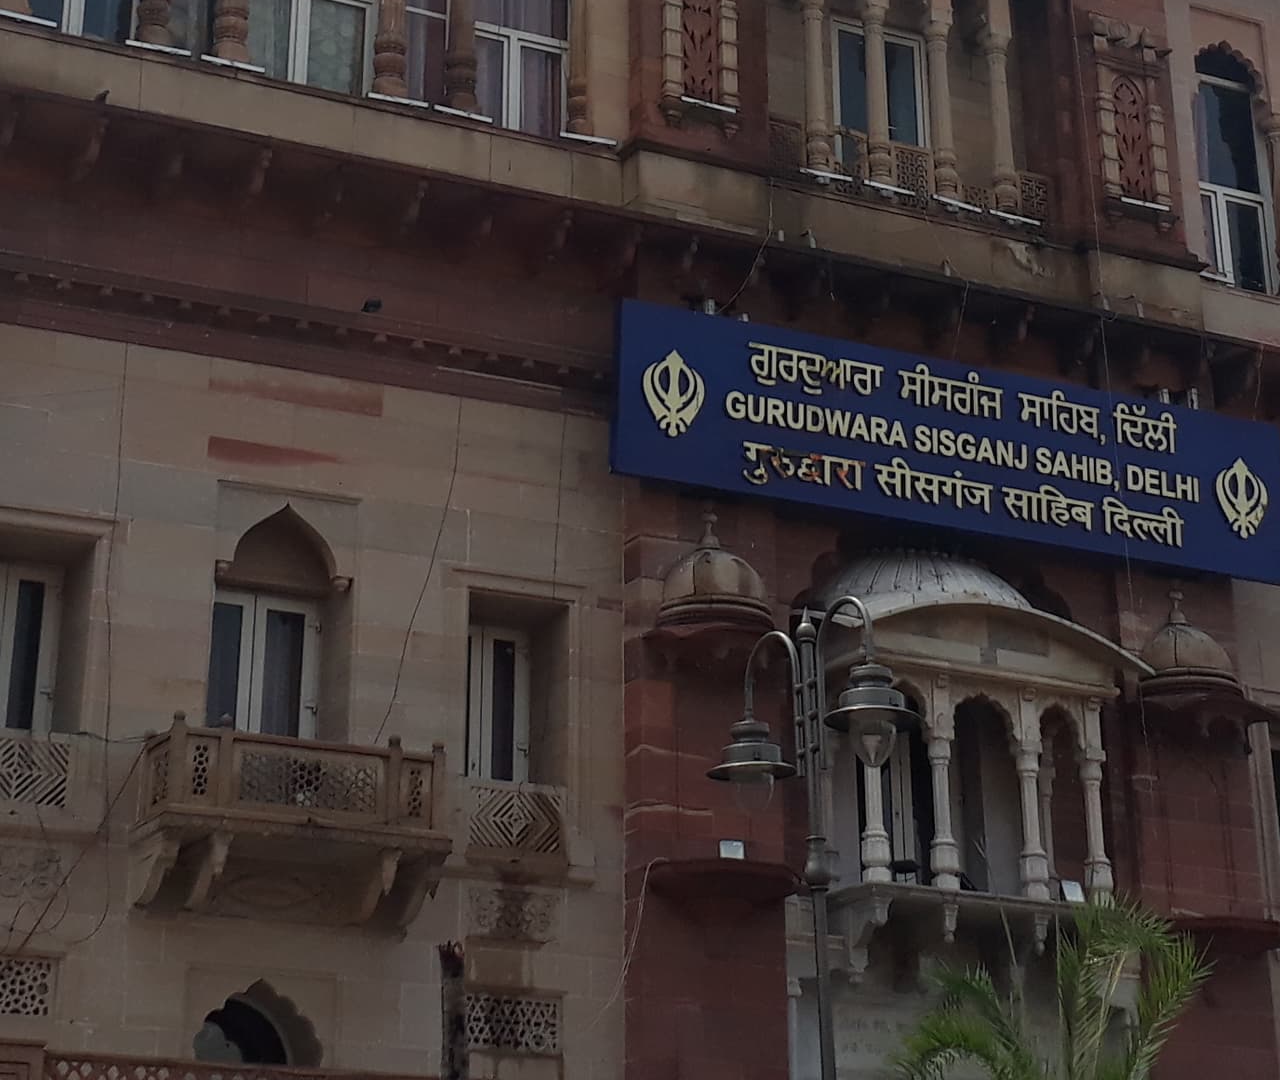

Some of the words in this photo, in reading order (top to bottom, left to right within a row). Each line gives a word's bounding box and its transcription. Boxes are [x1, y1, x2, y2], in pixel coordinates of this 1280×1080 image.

[725, 391, 908, 448] GURUDWARA
[914, 425, 1028, 470] SISGANJ
[1035, 447, 1120, 492] SAHIB,
[1126, 464, 1200, 503] DELHI
[748, 341, 884, 395] ਗੁਰਦੁਆਰਾ
[898, 363, 1004, 420] ਸੀਸਗੰਜ
[1018, 390, 1106, 446] ਸਾਹਿਬ,
[1114, 403, 1177, 454] ਦਿੱਲੀ
[874, 457, 994, 514] सीसगंज
[1001, 485, 1095, 531] साहिब
[1102, 497, 1185, 548] दिल्ली
